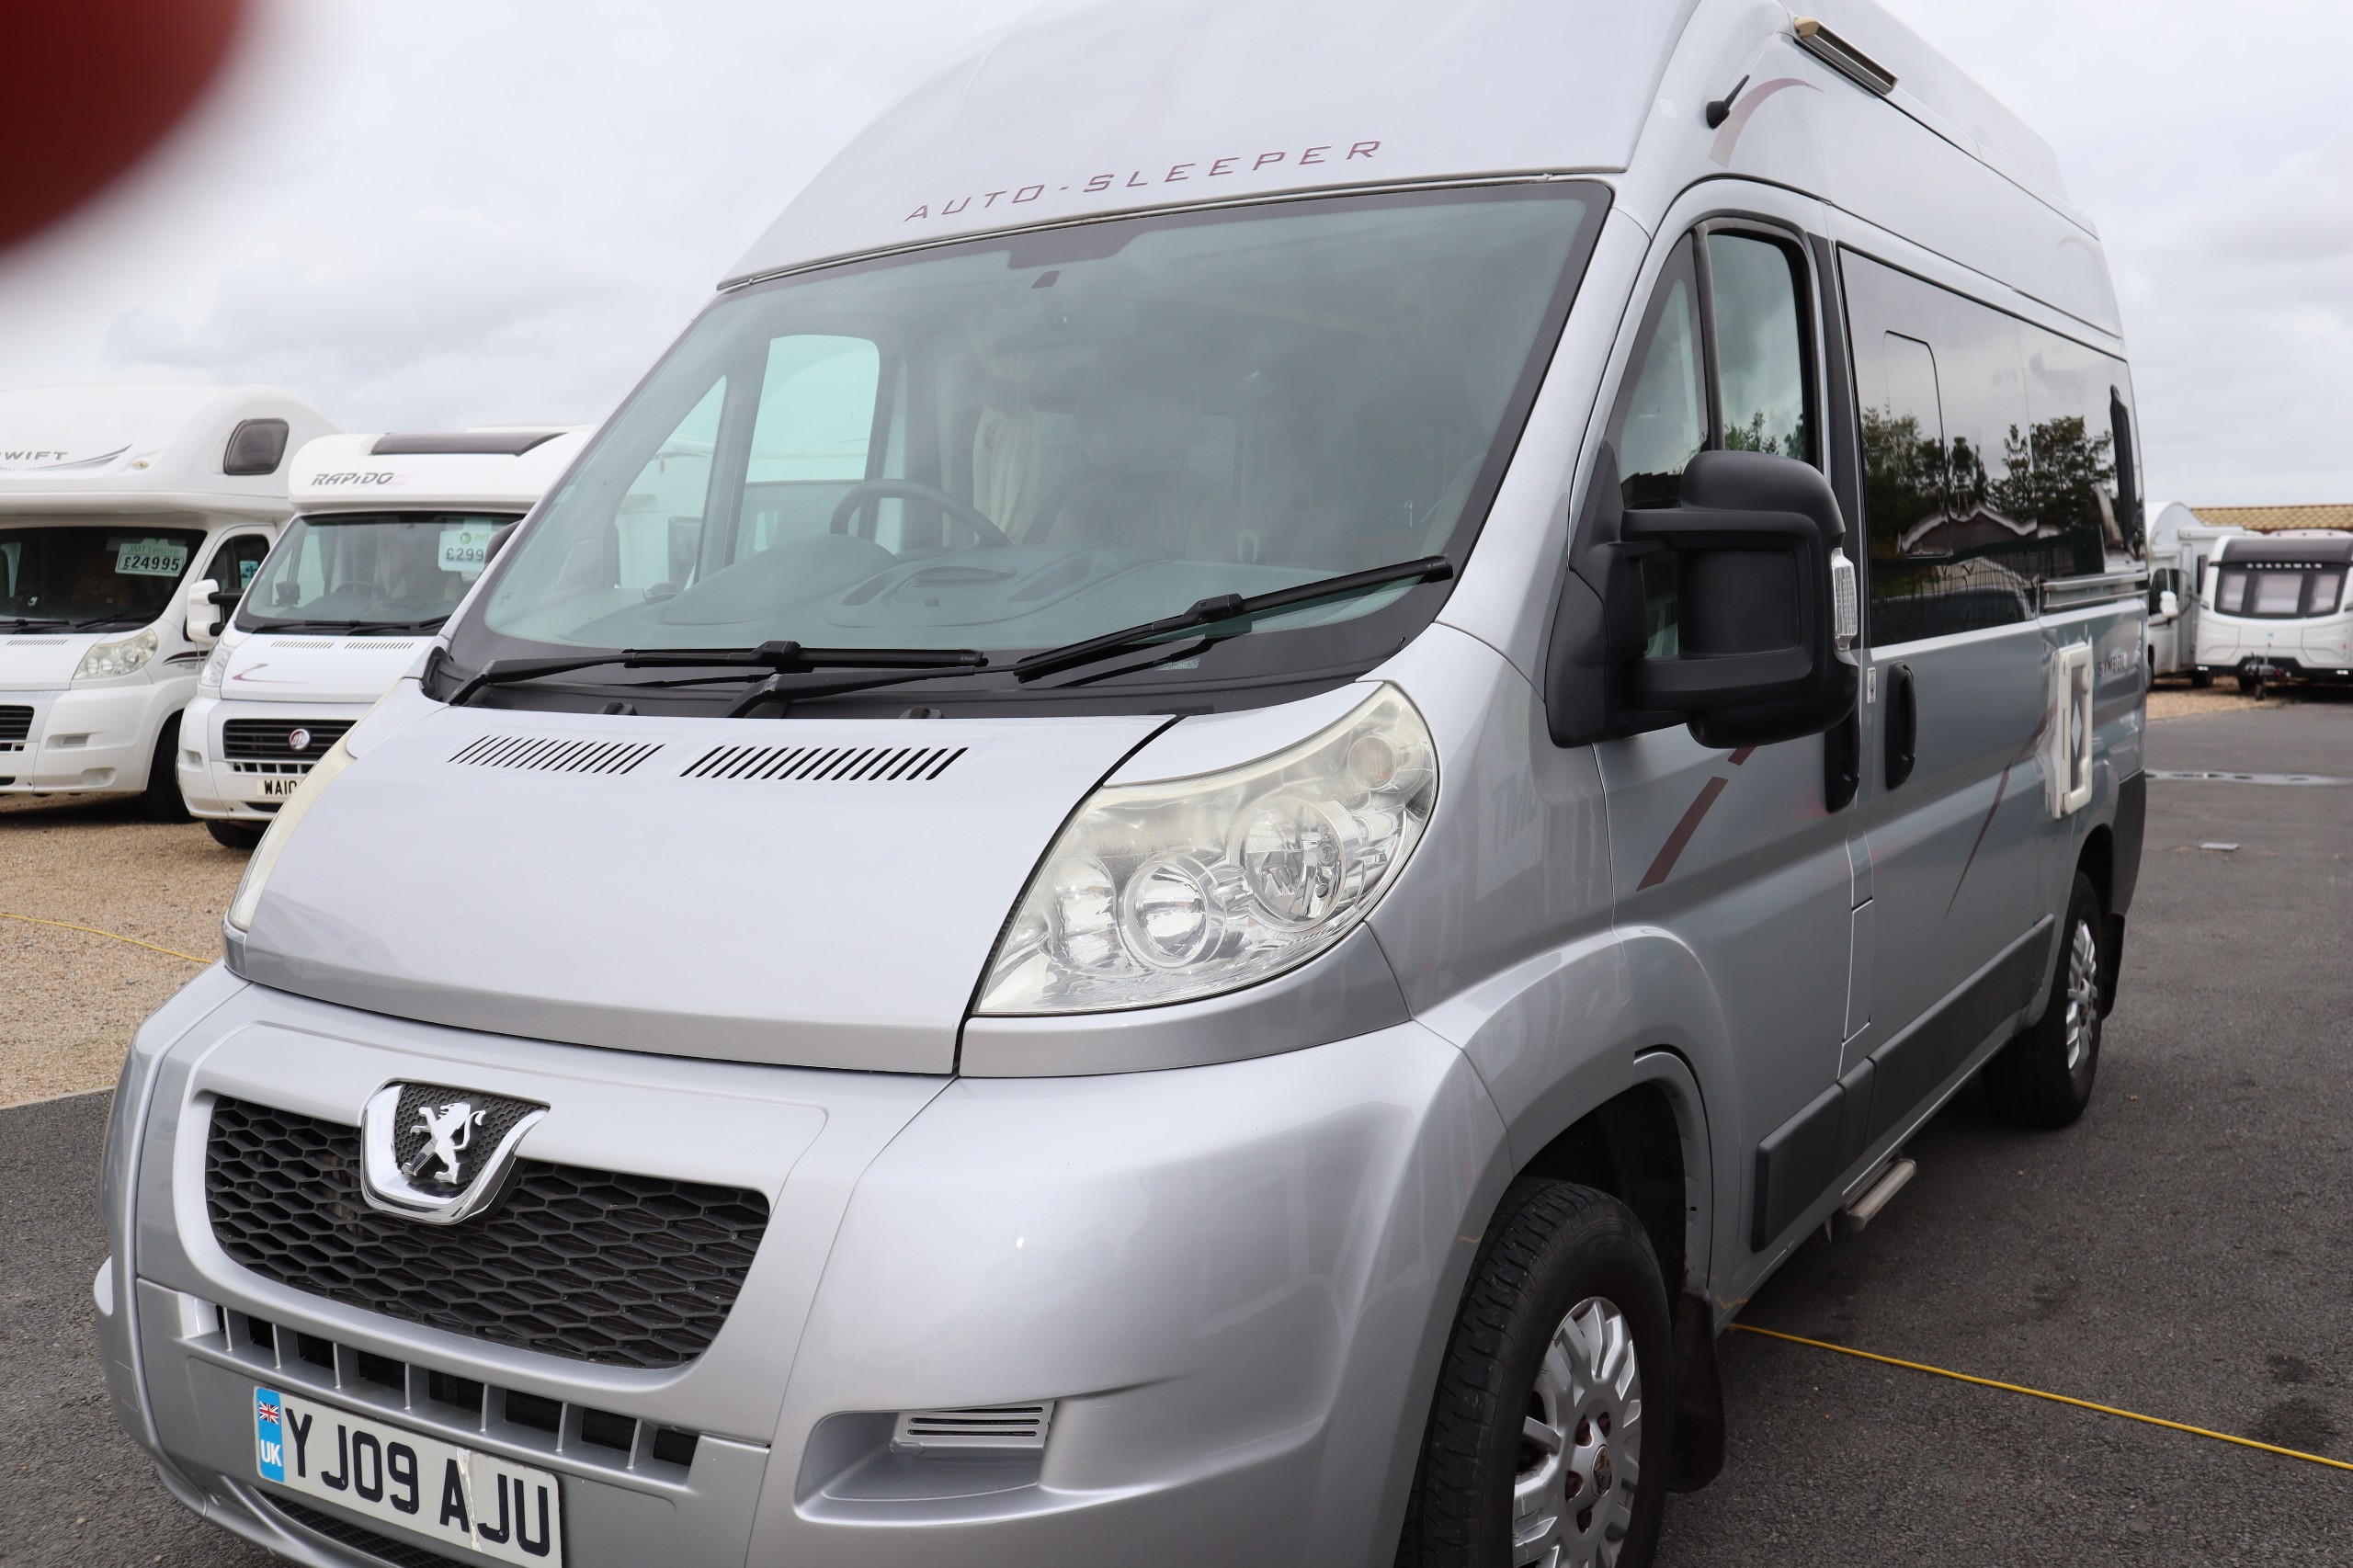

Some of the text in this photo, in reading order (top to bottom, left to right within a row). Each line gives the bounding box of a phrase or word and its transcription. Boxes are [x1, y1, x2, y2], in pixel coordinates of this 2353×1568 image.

[904, 140, 1381, 222] AUTO-SLEEPER
[0, 451, 68, 460] WIFT
[122, 555, 180, 571] £24995
[260, 1437, 282, 1468] UK
[286, 1407, 551, 1558] YJ09 AJU
